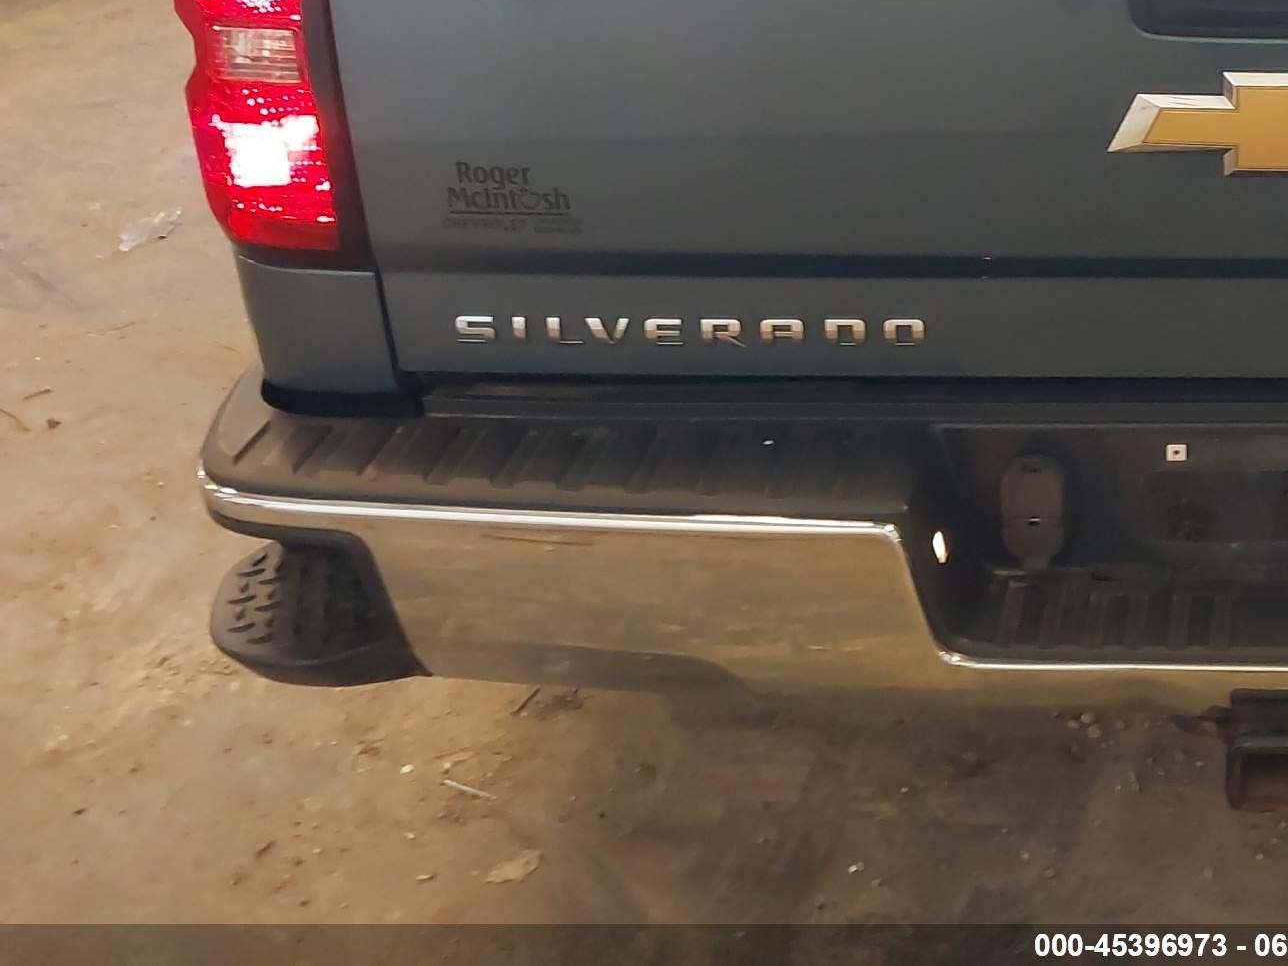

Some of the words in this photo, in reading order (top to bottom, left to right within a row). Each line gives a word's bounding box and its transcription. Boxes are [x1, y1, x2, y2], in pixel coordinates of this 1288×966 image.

[455, 161, 530, 190] Roger
[446, 186, 571, 211] McIntosh
[454, 314, 926, 346] SILVERADO
